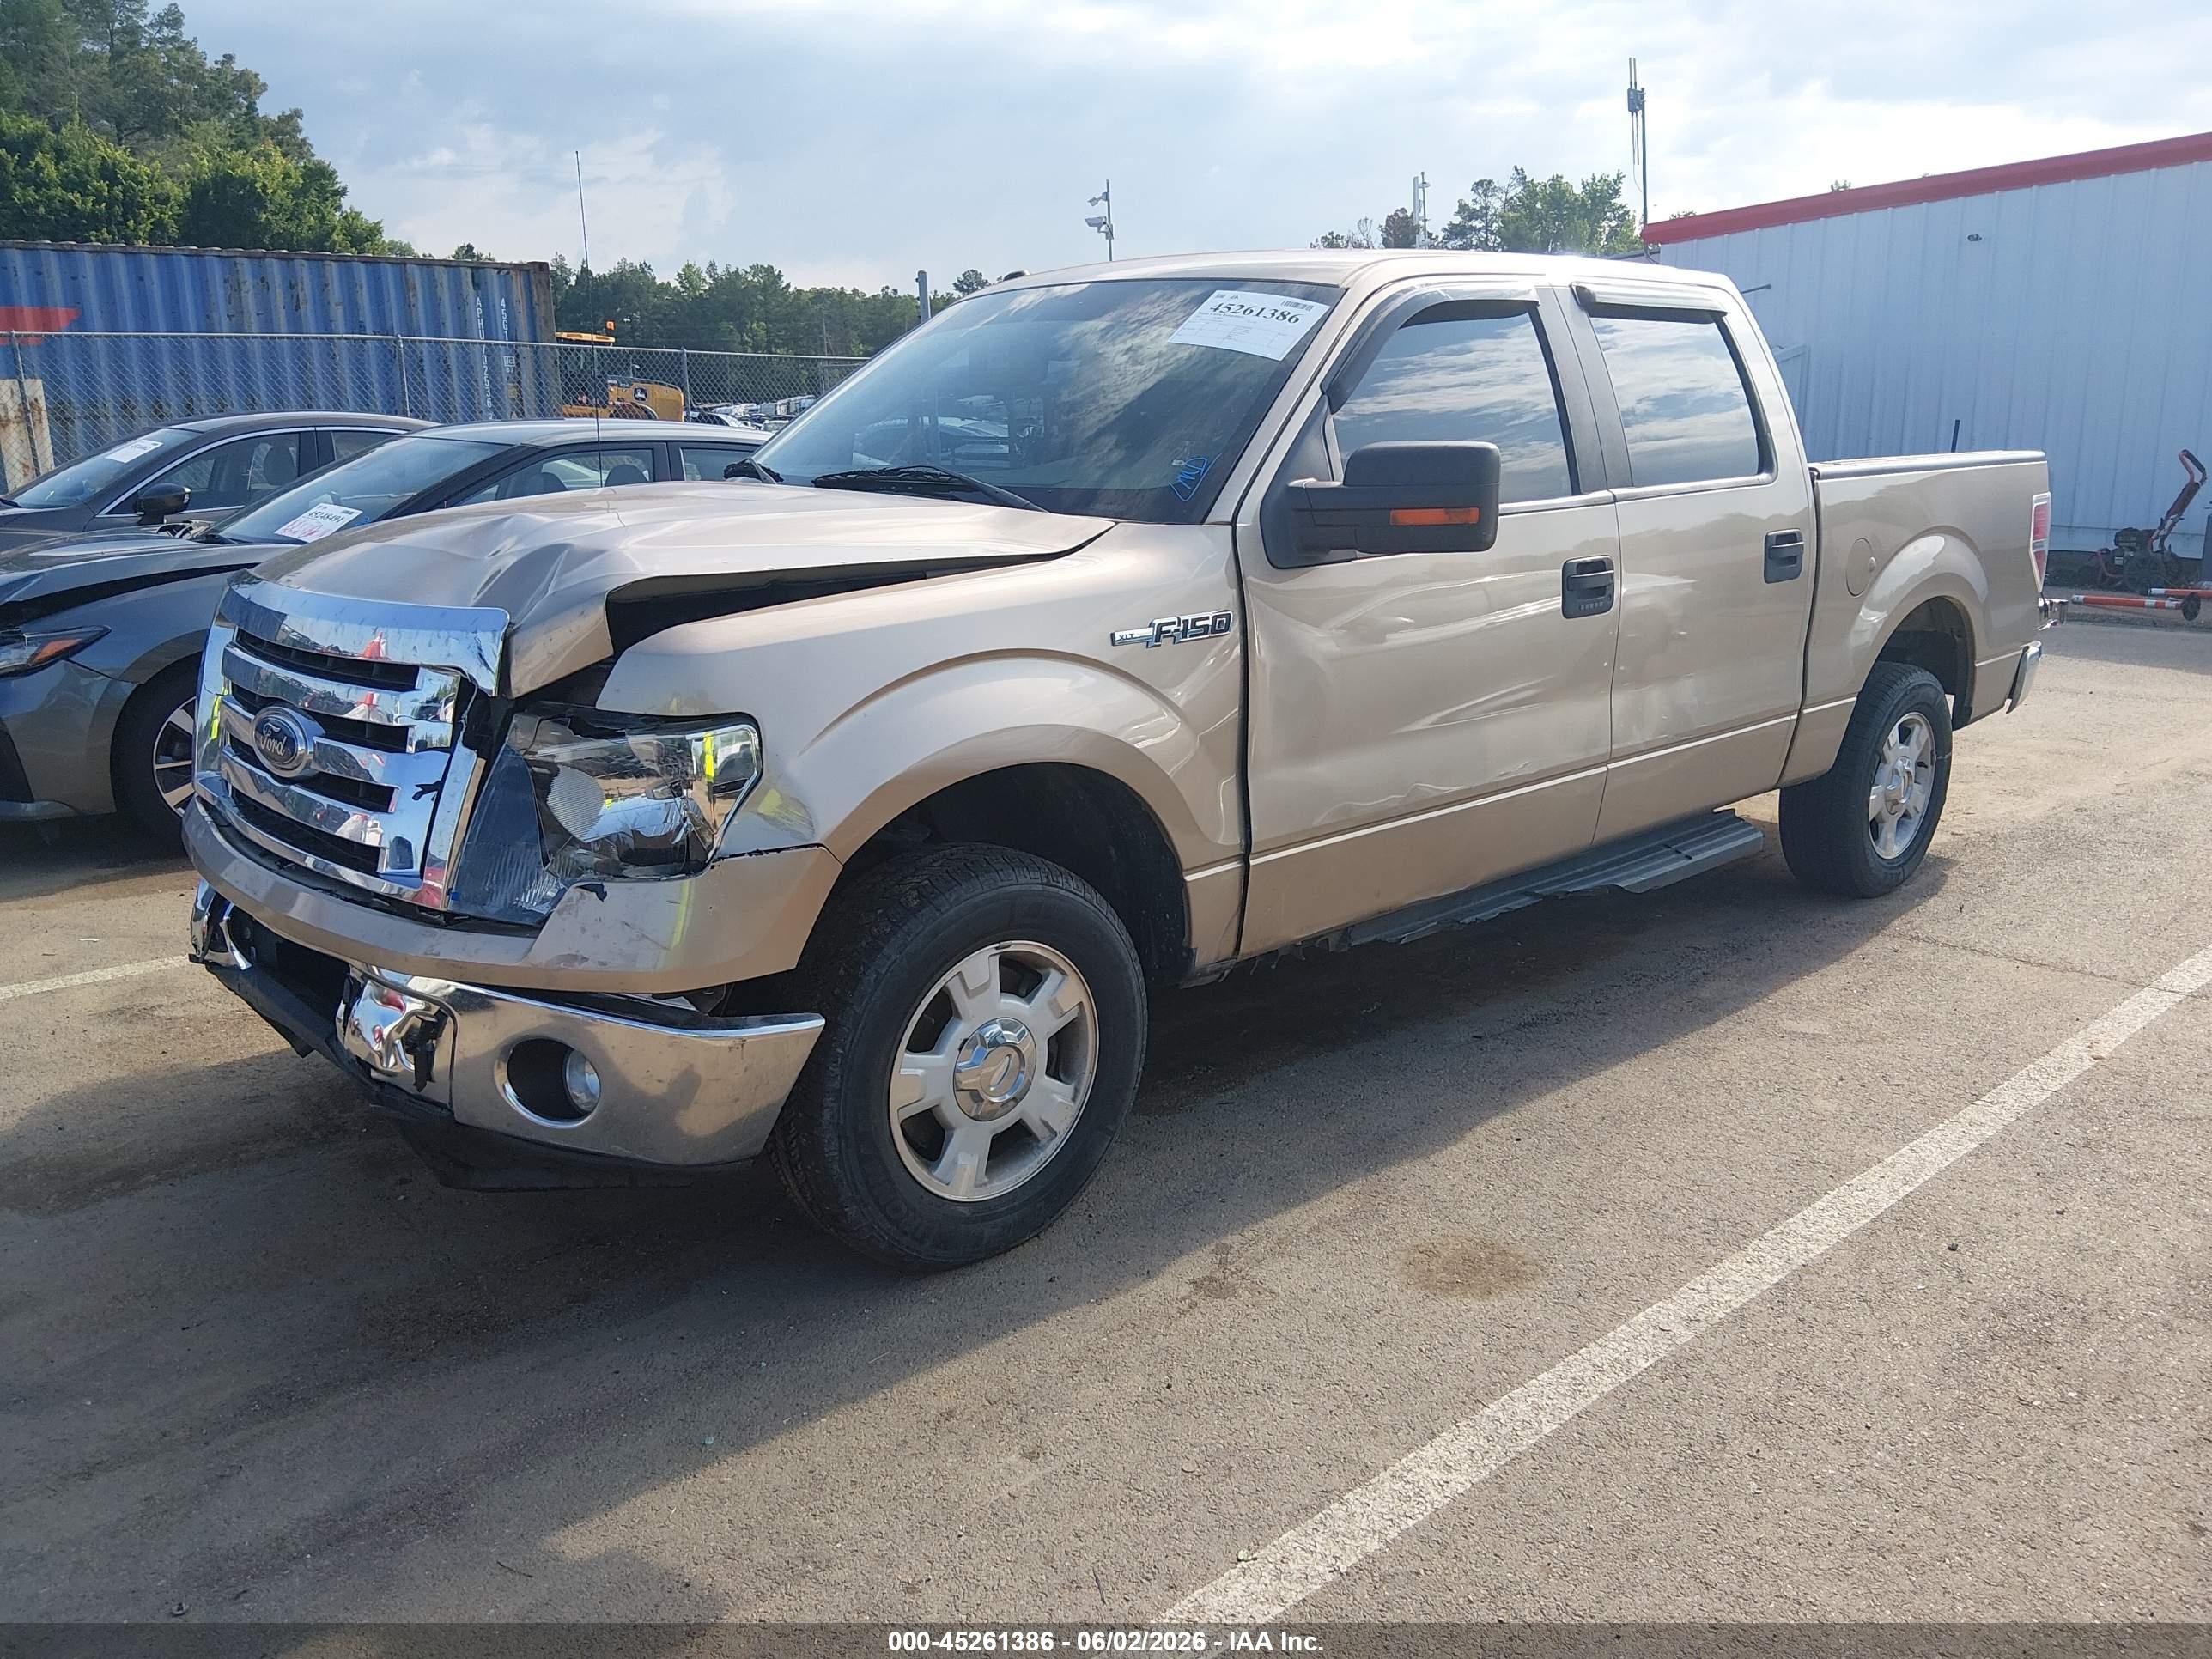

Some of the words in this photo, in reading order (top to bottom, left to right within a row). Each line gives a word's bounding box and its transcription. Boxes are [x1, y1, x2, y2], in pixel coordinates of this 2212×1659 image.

[476, 296, 485, 340] APHU
[501, 297, 509, 341] 45G1
[1210, 302, 1305, 324] 45261386
[260, 722, 288, 757] Ford
